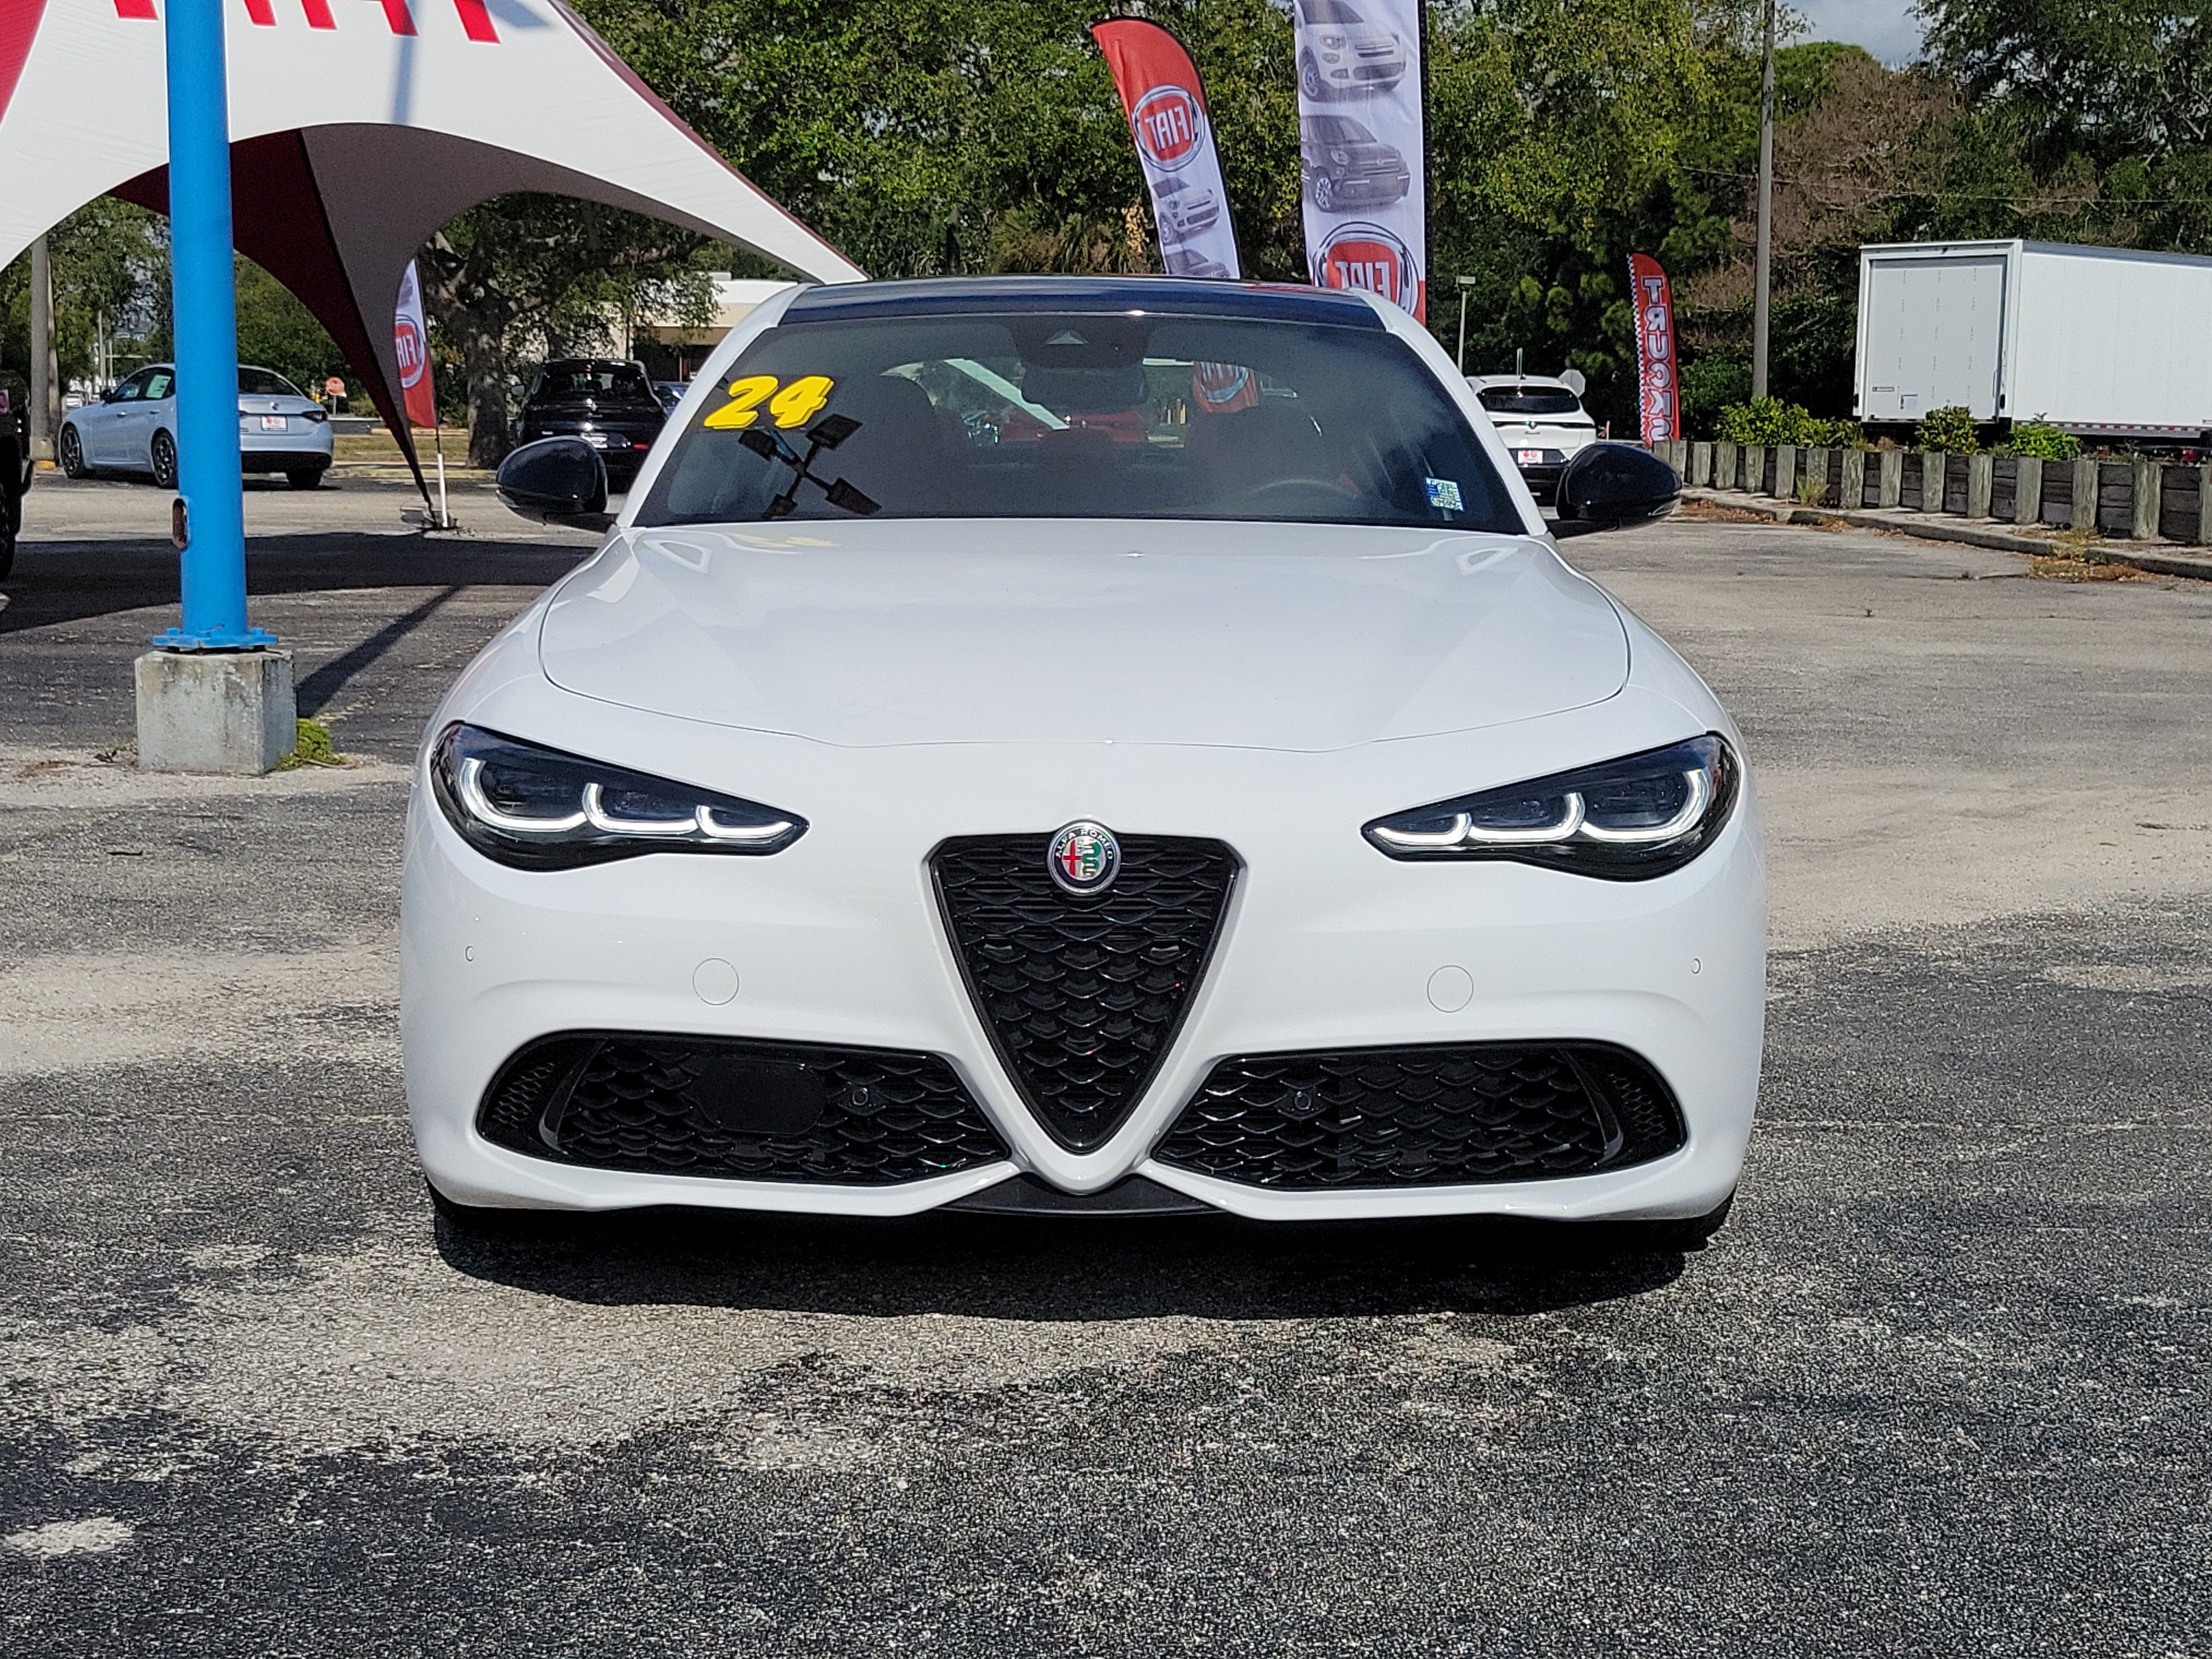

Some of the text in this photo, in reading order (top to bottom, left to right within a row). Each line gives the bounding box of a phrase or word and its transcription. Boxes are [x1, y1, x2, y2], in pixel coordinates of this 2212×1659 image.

[704, 376, 834, 428] 24
[1055, 829, 1113, 860] ALFA ROMEO
